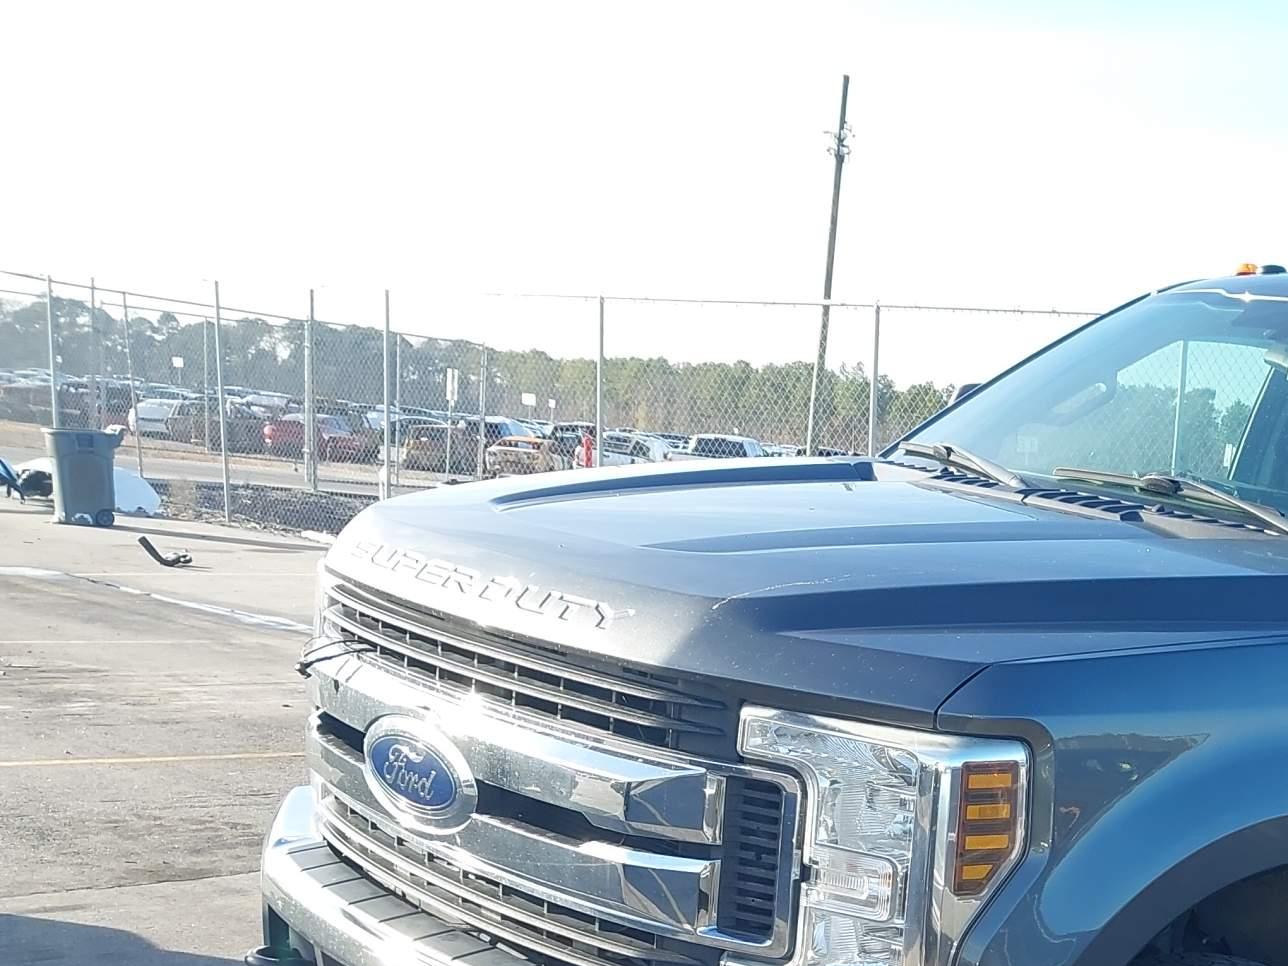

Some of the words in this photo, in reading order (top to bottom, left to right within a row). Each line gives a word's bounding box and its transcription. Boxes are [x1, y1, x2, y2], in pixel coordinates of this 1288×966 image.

[350, 540, 481, 594] SUPER
[478, 574, 637, 630] DUTY
[383, 743, 438, 801] Ford
